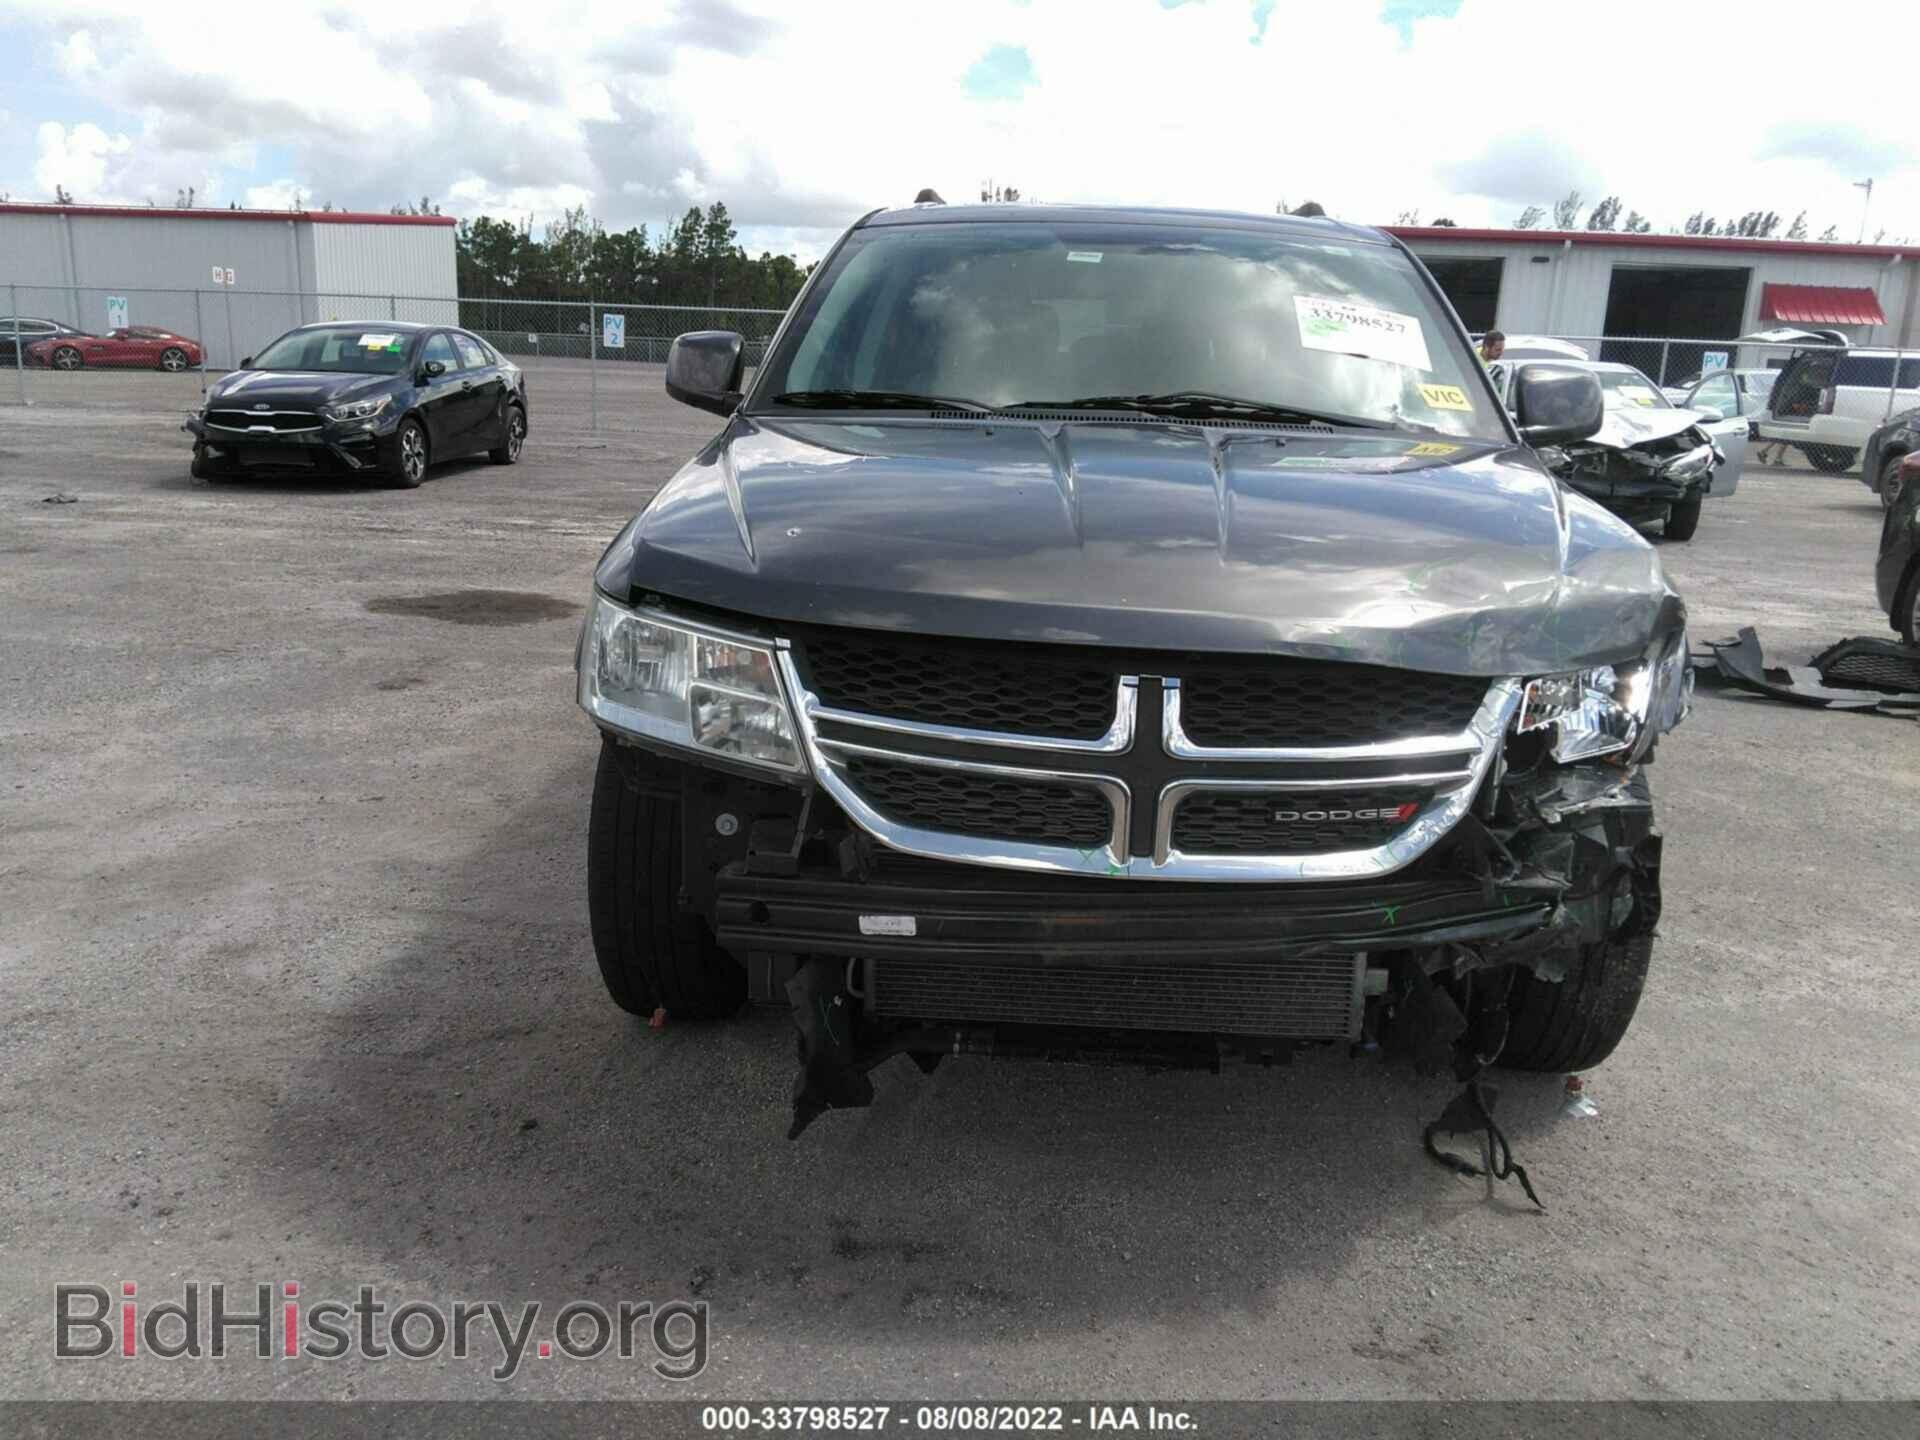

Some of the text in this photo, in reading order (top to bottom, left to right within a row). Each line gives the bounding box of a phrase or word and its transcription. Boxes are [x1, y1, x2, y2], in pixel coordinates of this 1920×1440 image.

[110, 299, 126, 310] PV
[605, 316, 624, 329] PV
[610, 333, 619, 345] 2
[1704, 354, 1726, 368] PV
[1424, 389, 1465, 405] VIC
[1274, 807, 1402, 822] DODGE
